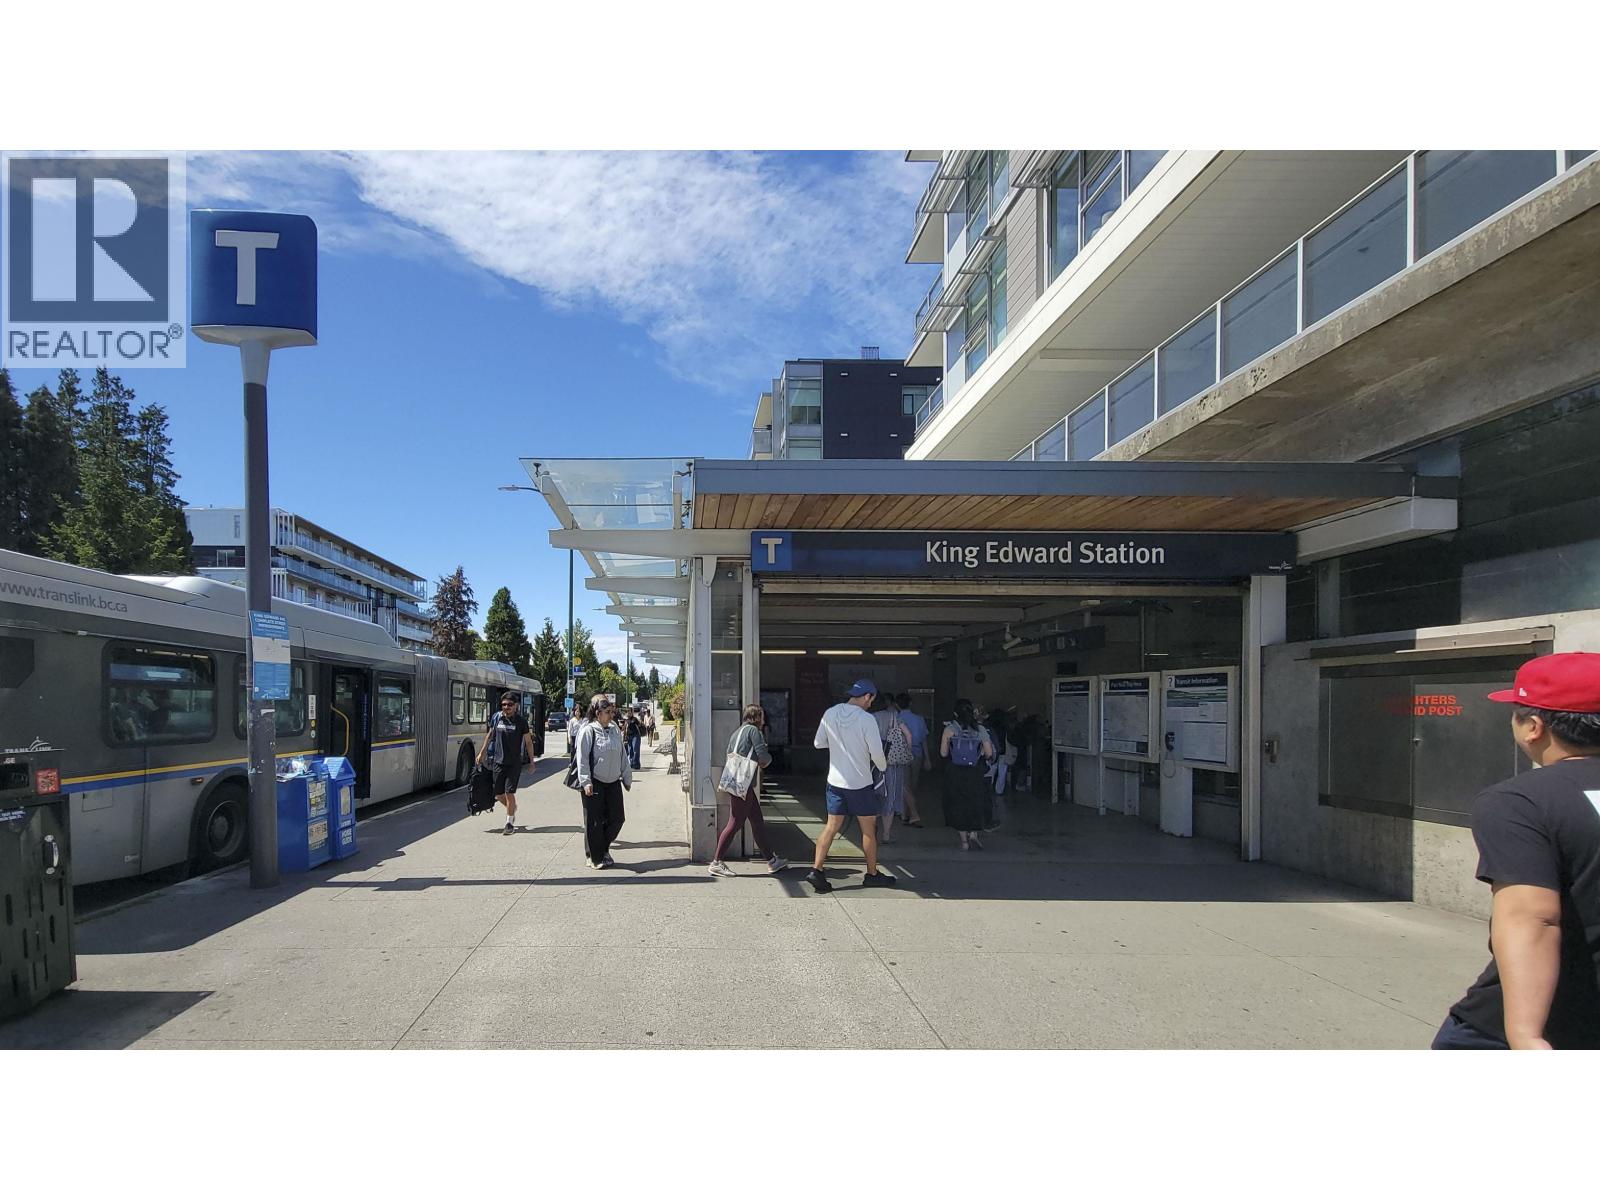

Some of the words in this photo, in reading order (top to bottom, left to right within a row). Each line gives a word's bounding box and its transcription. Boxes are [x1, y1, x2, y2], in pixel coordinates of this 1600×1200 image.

[215, 229, 280, 305] T
[760, 537, 783, 564] T
[926, 540, 980, 568] King
[986, 540, 1072, 563] Edward
[1079, 541, 1165, 564] Station
[0, 582, 128, 613] www.translink.bc.ca
[1415, 695, 1457, 705] HTERS
[1429, 706, 1463, 716] POST
